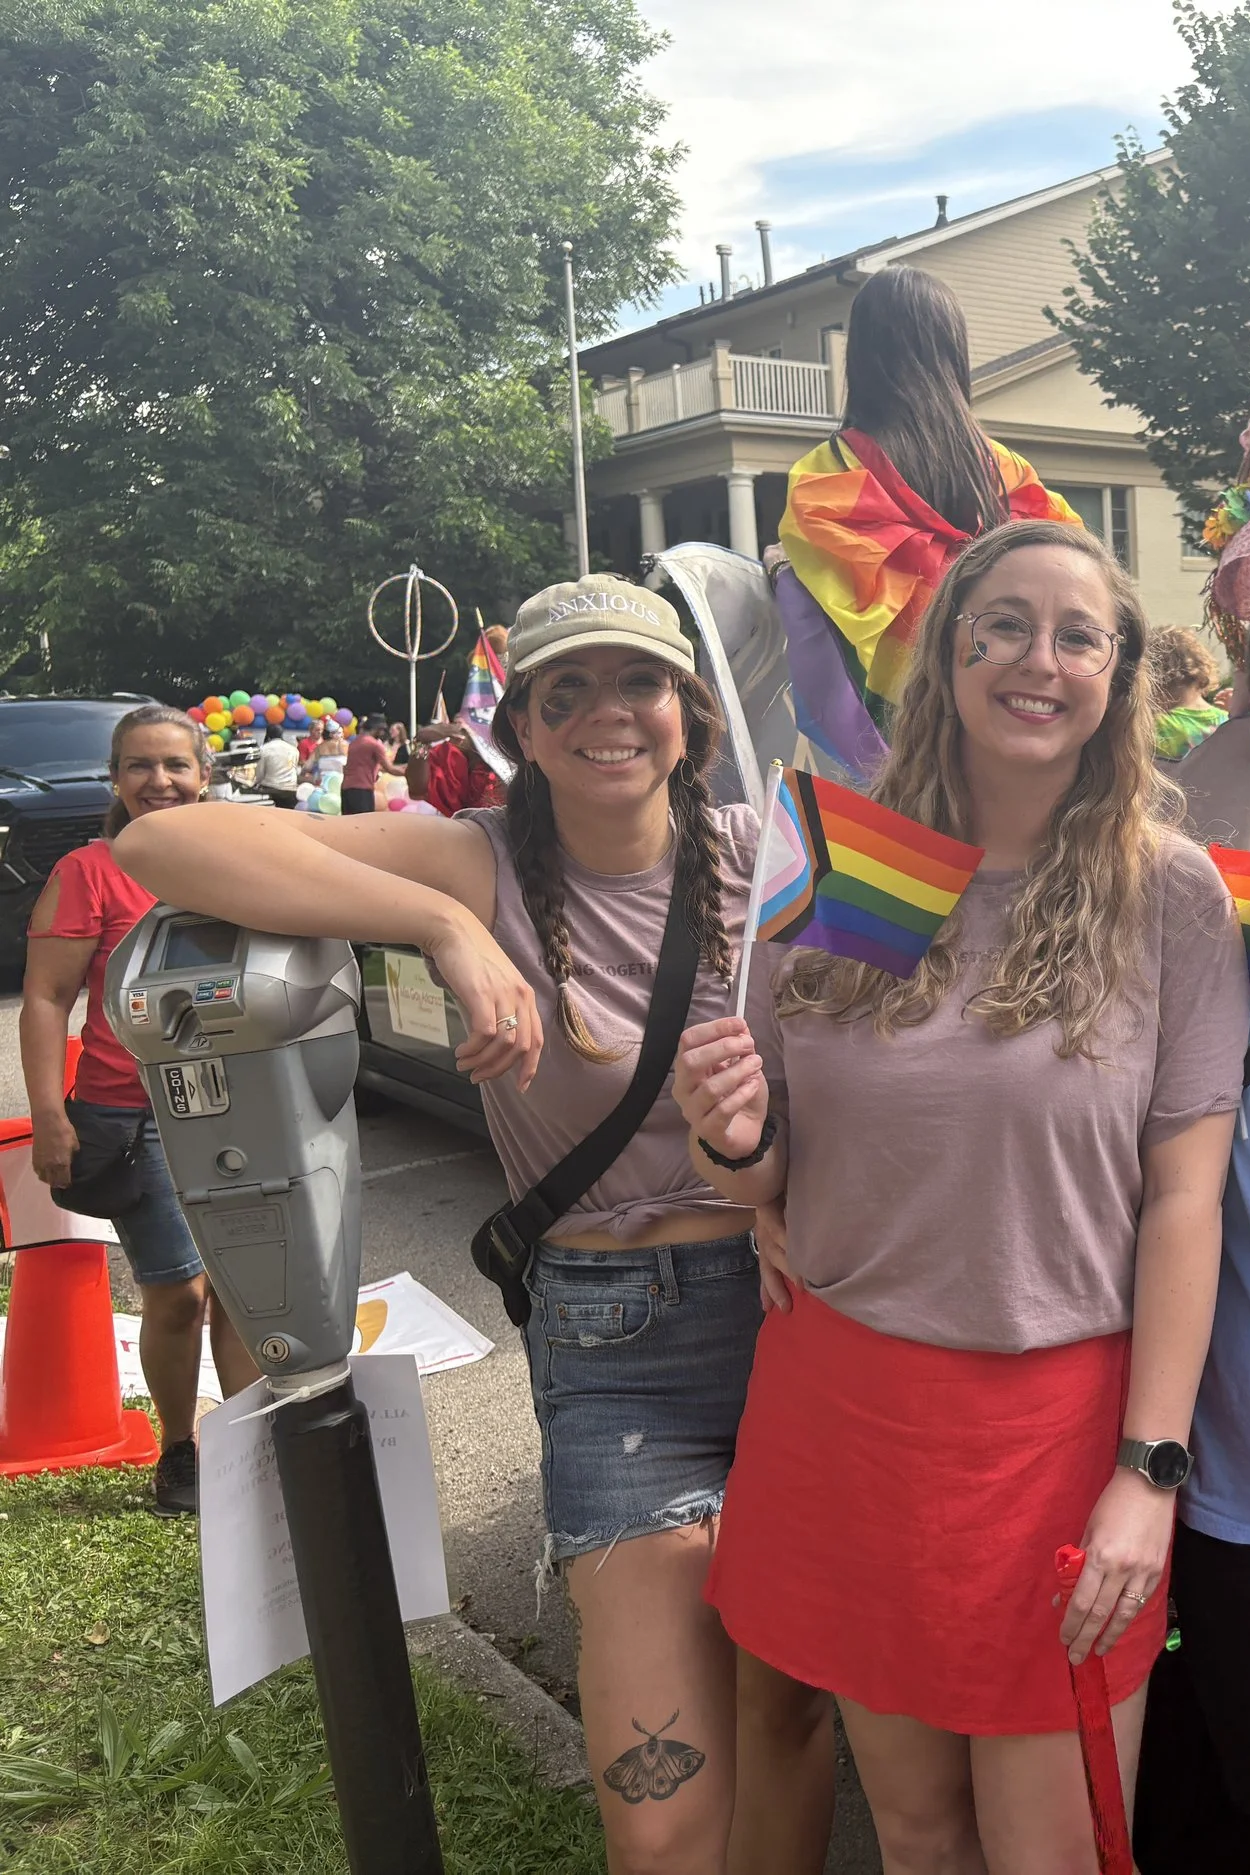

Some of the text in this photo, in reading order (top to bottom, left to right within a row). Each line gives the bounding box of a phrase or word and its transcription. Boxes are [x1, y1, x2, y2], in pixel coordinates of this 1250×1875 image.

[545, 592, 662, 627] ANXIOUS
[600, 961, 658, 977] TOGETH
[169, 1070, 187, 1112] COINS
